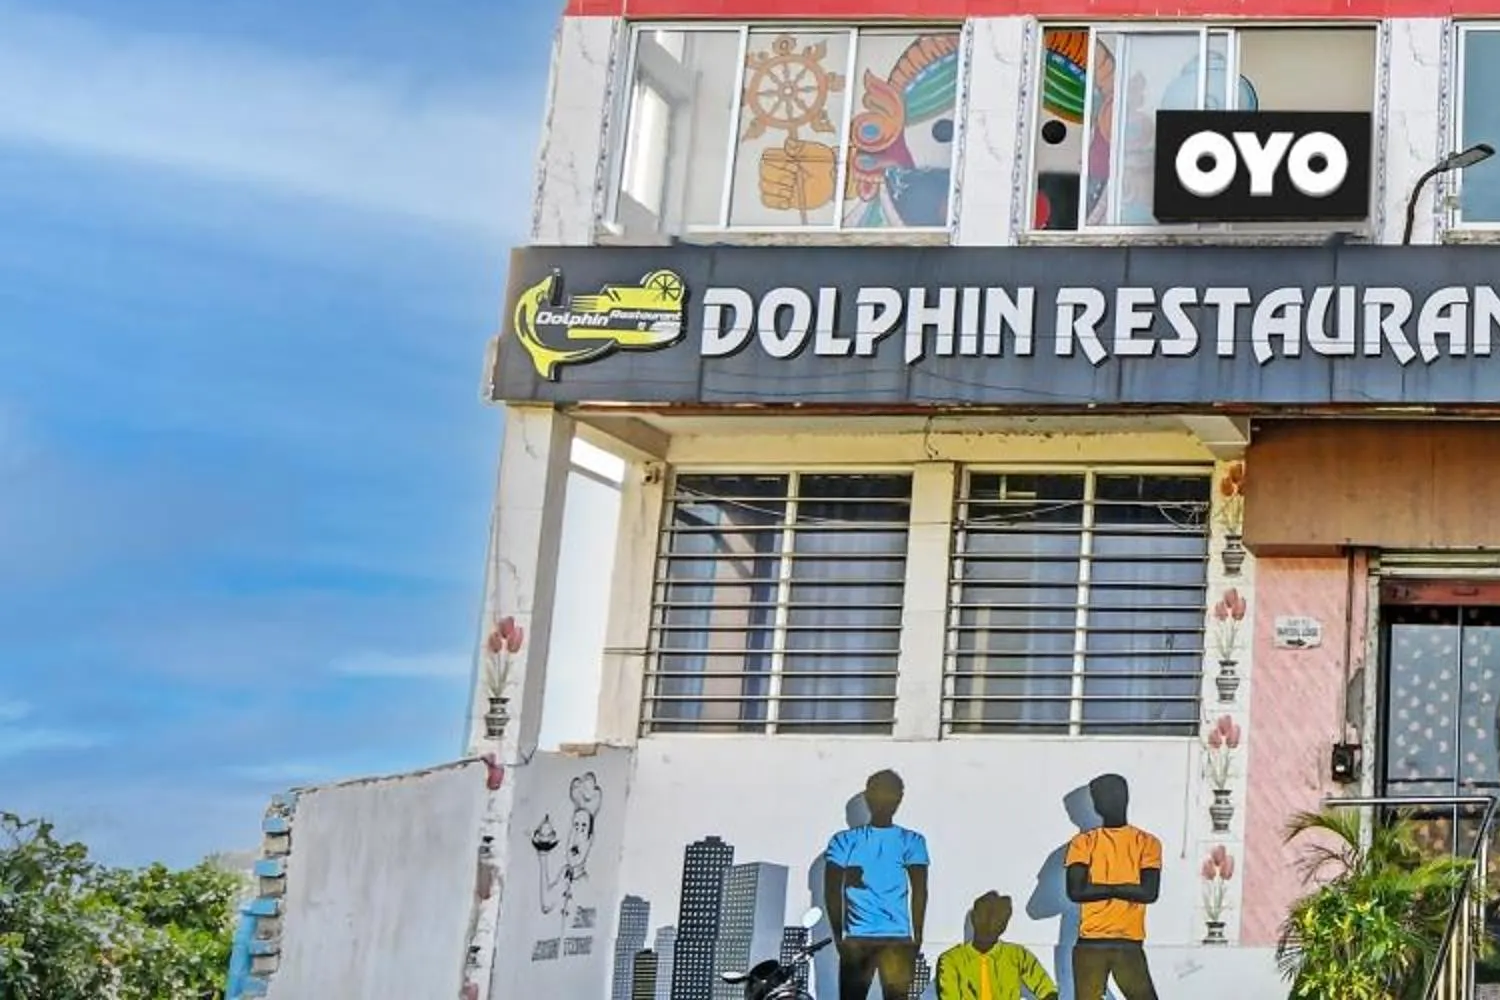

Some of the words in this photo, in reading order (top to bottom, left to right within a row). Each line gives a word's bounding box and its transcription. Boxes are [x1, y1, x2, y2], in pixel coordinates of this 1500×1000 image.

[1175, 131, 1348, 197] OYO
[536, 311, 609, 328] Dolphin
[701, 286, 1036, 364] DOLPHIN
